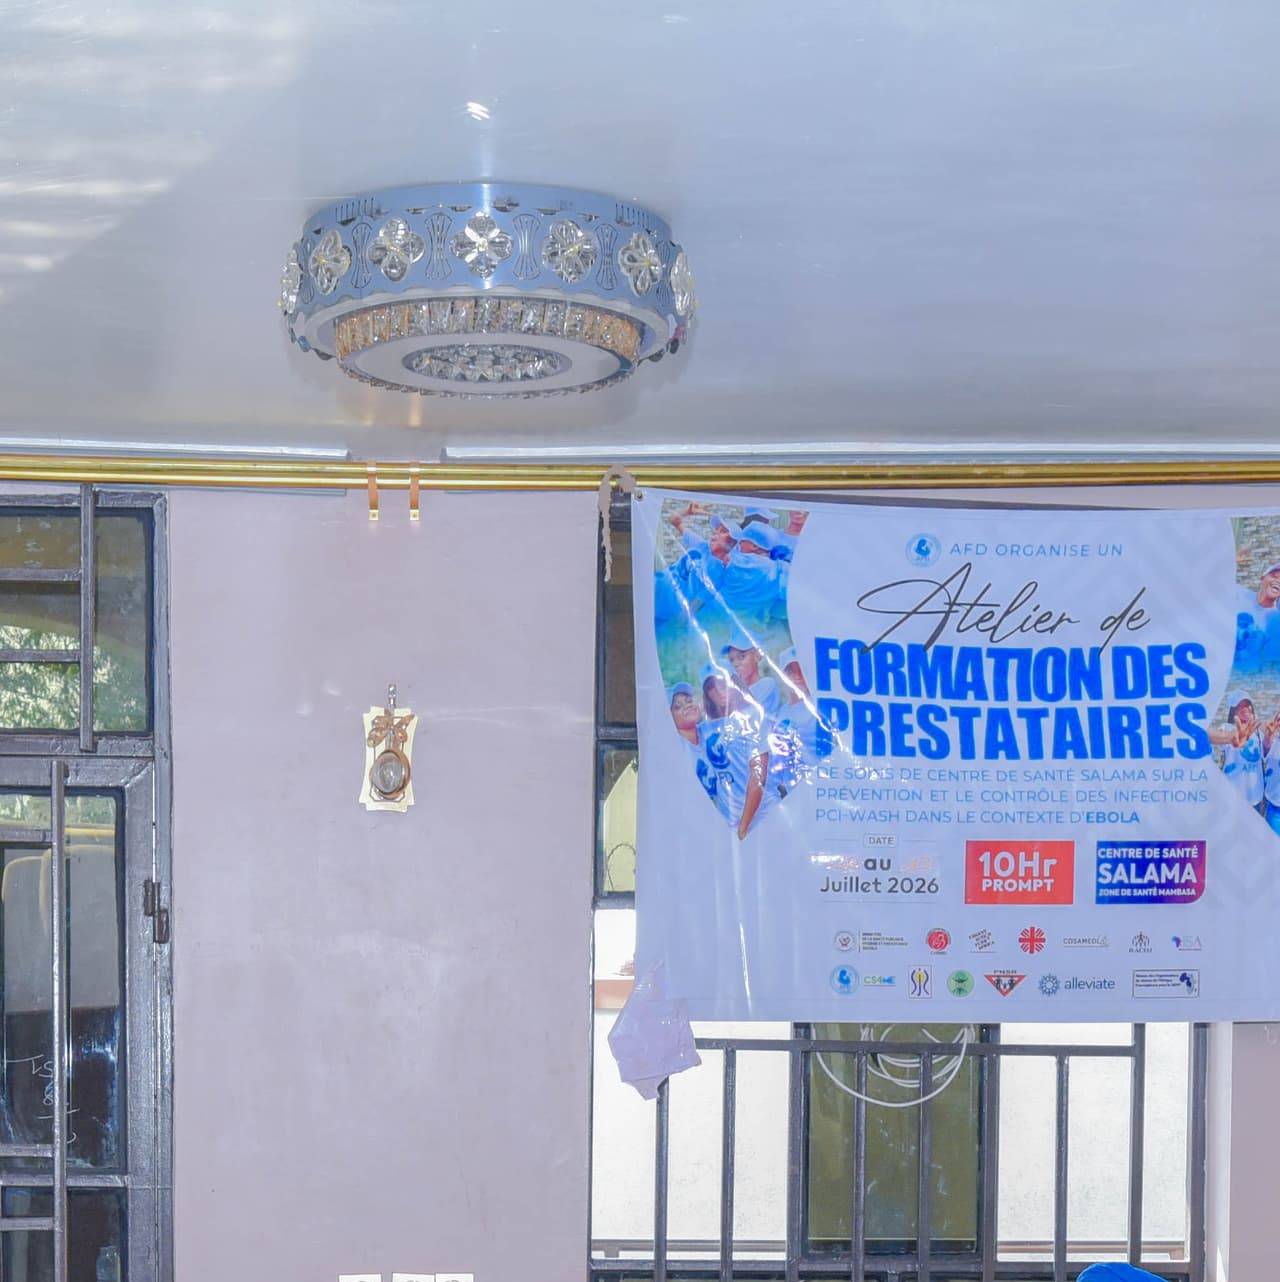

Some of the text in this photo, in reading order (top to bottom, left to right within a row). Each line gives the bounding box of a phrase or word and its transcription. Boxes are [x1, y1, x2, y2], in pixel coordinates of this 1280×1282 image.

[949, 543, 1124, 558] AFD ORGANISE UN
[856, 562, 1151, 657] Atelier de
[814, 637, 1211, 702] FORMATION DES
[815, 697, 1212, 761] PRESTATAIRES
[899, 767, 921, 782] DE
[927, 769, 992, 783] CENTRE
[996, 769, 1018, 783] DE
[1023, 766, 1076, 783] SANTÉ
[1080, 768, 1148, 783] SALAMA
[1152, 768, 1185, 783] SUR
[1189, 768, 1209, 782] LA
[816, 785, 1209, 804] PRÉVENTION ET LE CONTRÔLE DES INFECTIONS
[815, 808, 1141, 825] PCI-WASH DANS LE CONTEXTE D'EBOLA
[868, 836, 895, 846] DATE
[1097, 844, 1199, 860] CENTRE DE SANTÉ
[863, 857, 892, 872] au
[978, 851, 1059, 878] 10Hr
[1097, 862, 1198, 885] SALAMA
[819, 875, 940, 894] Juillet 2026
[981, 879, 1055, 893] PROMPT
[1098, 888, 1120, 897] ZONE
[1120, 888, 1133, 897] DE
[1158, 887, 1197, 897] MAMBASA
[1063, 976, 1116, 990] alleviate
